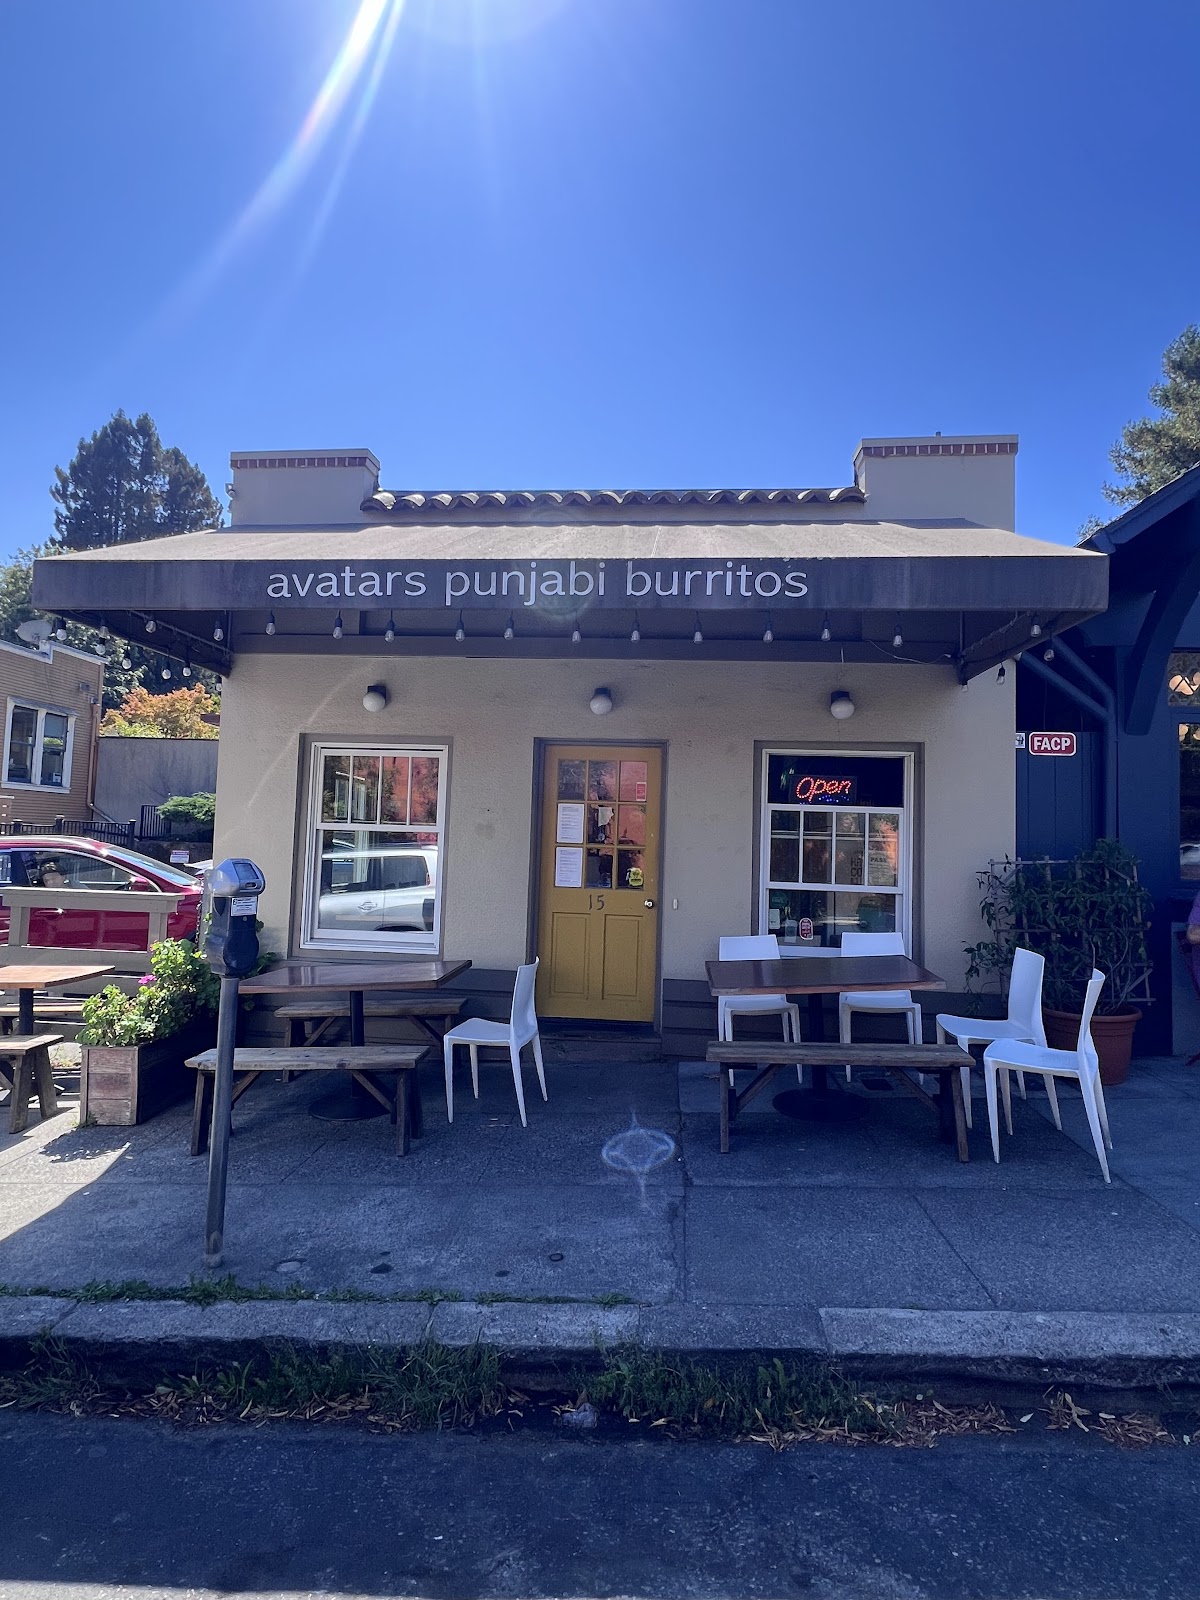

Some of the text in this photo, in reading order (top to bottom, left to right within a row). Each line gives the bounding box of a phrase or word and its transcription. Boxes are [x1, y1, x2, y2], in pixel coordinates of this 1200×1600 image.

[267, 561, 808, 606] avatars punjabi burritos
[1033, 736, 1071, 751] FACP
[796, 777, 852, 803] Open
[589, 894, 604, 911] 15
